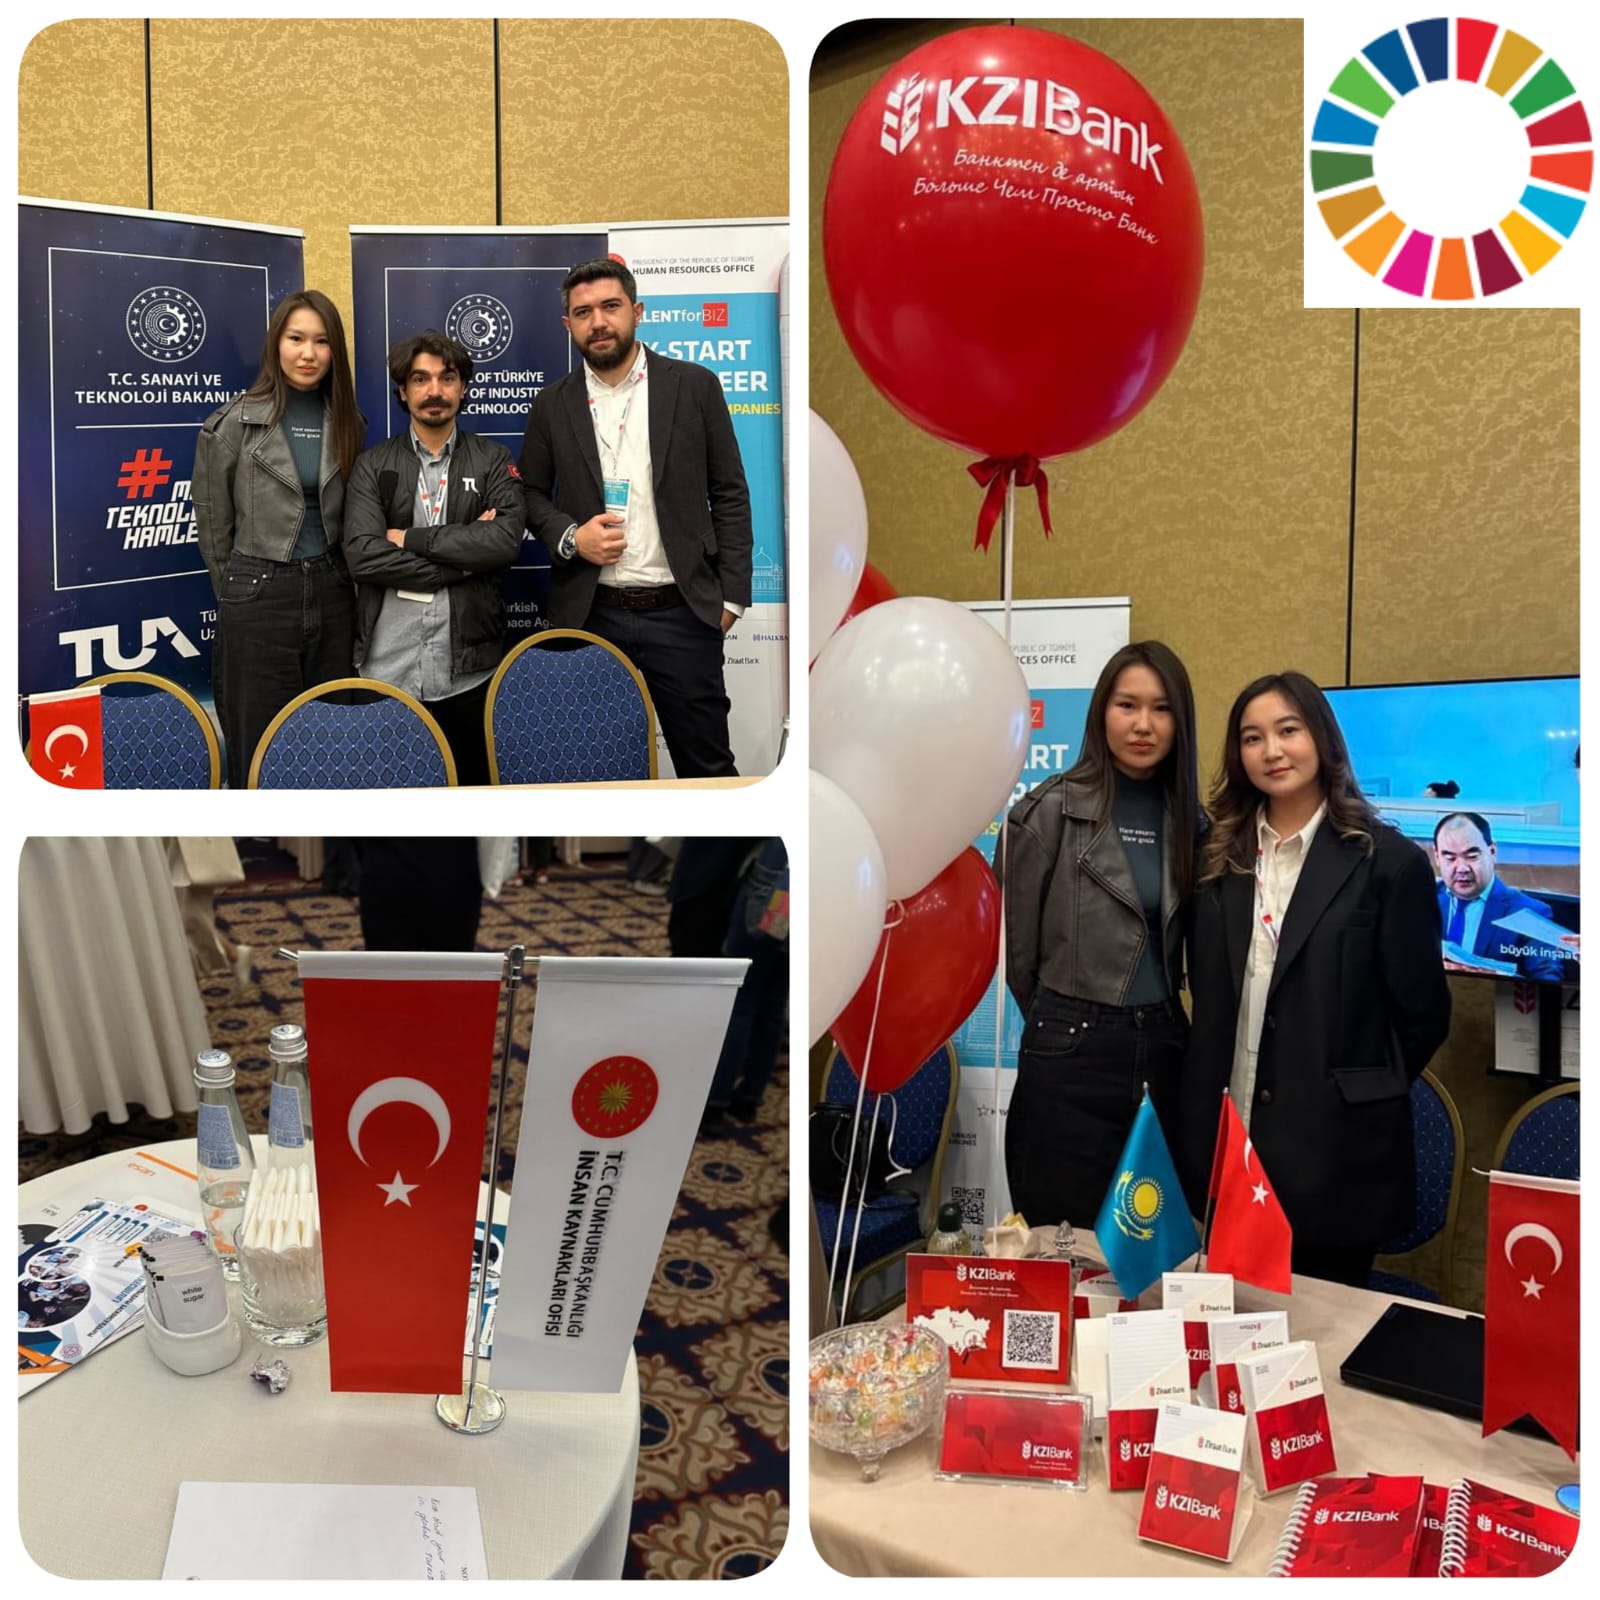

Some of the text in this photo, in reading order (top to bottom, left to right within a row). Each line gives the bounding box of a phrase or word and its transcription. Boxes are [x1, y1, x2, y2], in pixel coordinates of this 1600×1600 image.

[935, 75, 1164, 185] KZIBank
[953, 149, 1048, 174] Банктен
[913, 177, 1159, 244] Больше Чем Просто Банк
[632, 264, 755, 275] HUMAN RESOURCES OFFICE
[639, 307, 726, 323] LENTforBIZ
[108, 371, 222, 386] T.C. SANAYİ VE
[475, 369, 545, 383] OF TÜRKİYE
[75, 388, 168, 404] TEKNOLOJİ
[469, 387, 486, 399] OF
[123, 522, 199, 549] HAMLE
[1040, 655, 1076, 664] OFFICE
[1500, 943, 1538, 957] büyük
[544, 1150, 600, 1337] İNSAN KAYNAKLARI OFİSİ
[566, 1150, 623, 1338] T.C. CUMHURBAŞKANLIĞI
[969, 1267, 1016, 1281] KZIBank
[181, 1286, 203, 1297] white
[1282, 1430, 1324, 1455] KZIBank
[1032, 1444, 1073, 1459] KZIBank
[1169, 1493, 1222, 1521] KZIBank
[1332, 1510, 1399, 1524] KZIBank
[1495, 1523, 1568, 1559] KZIBank
